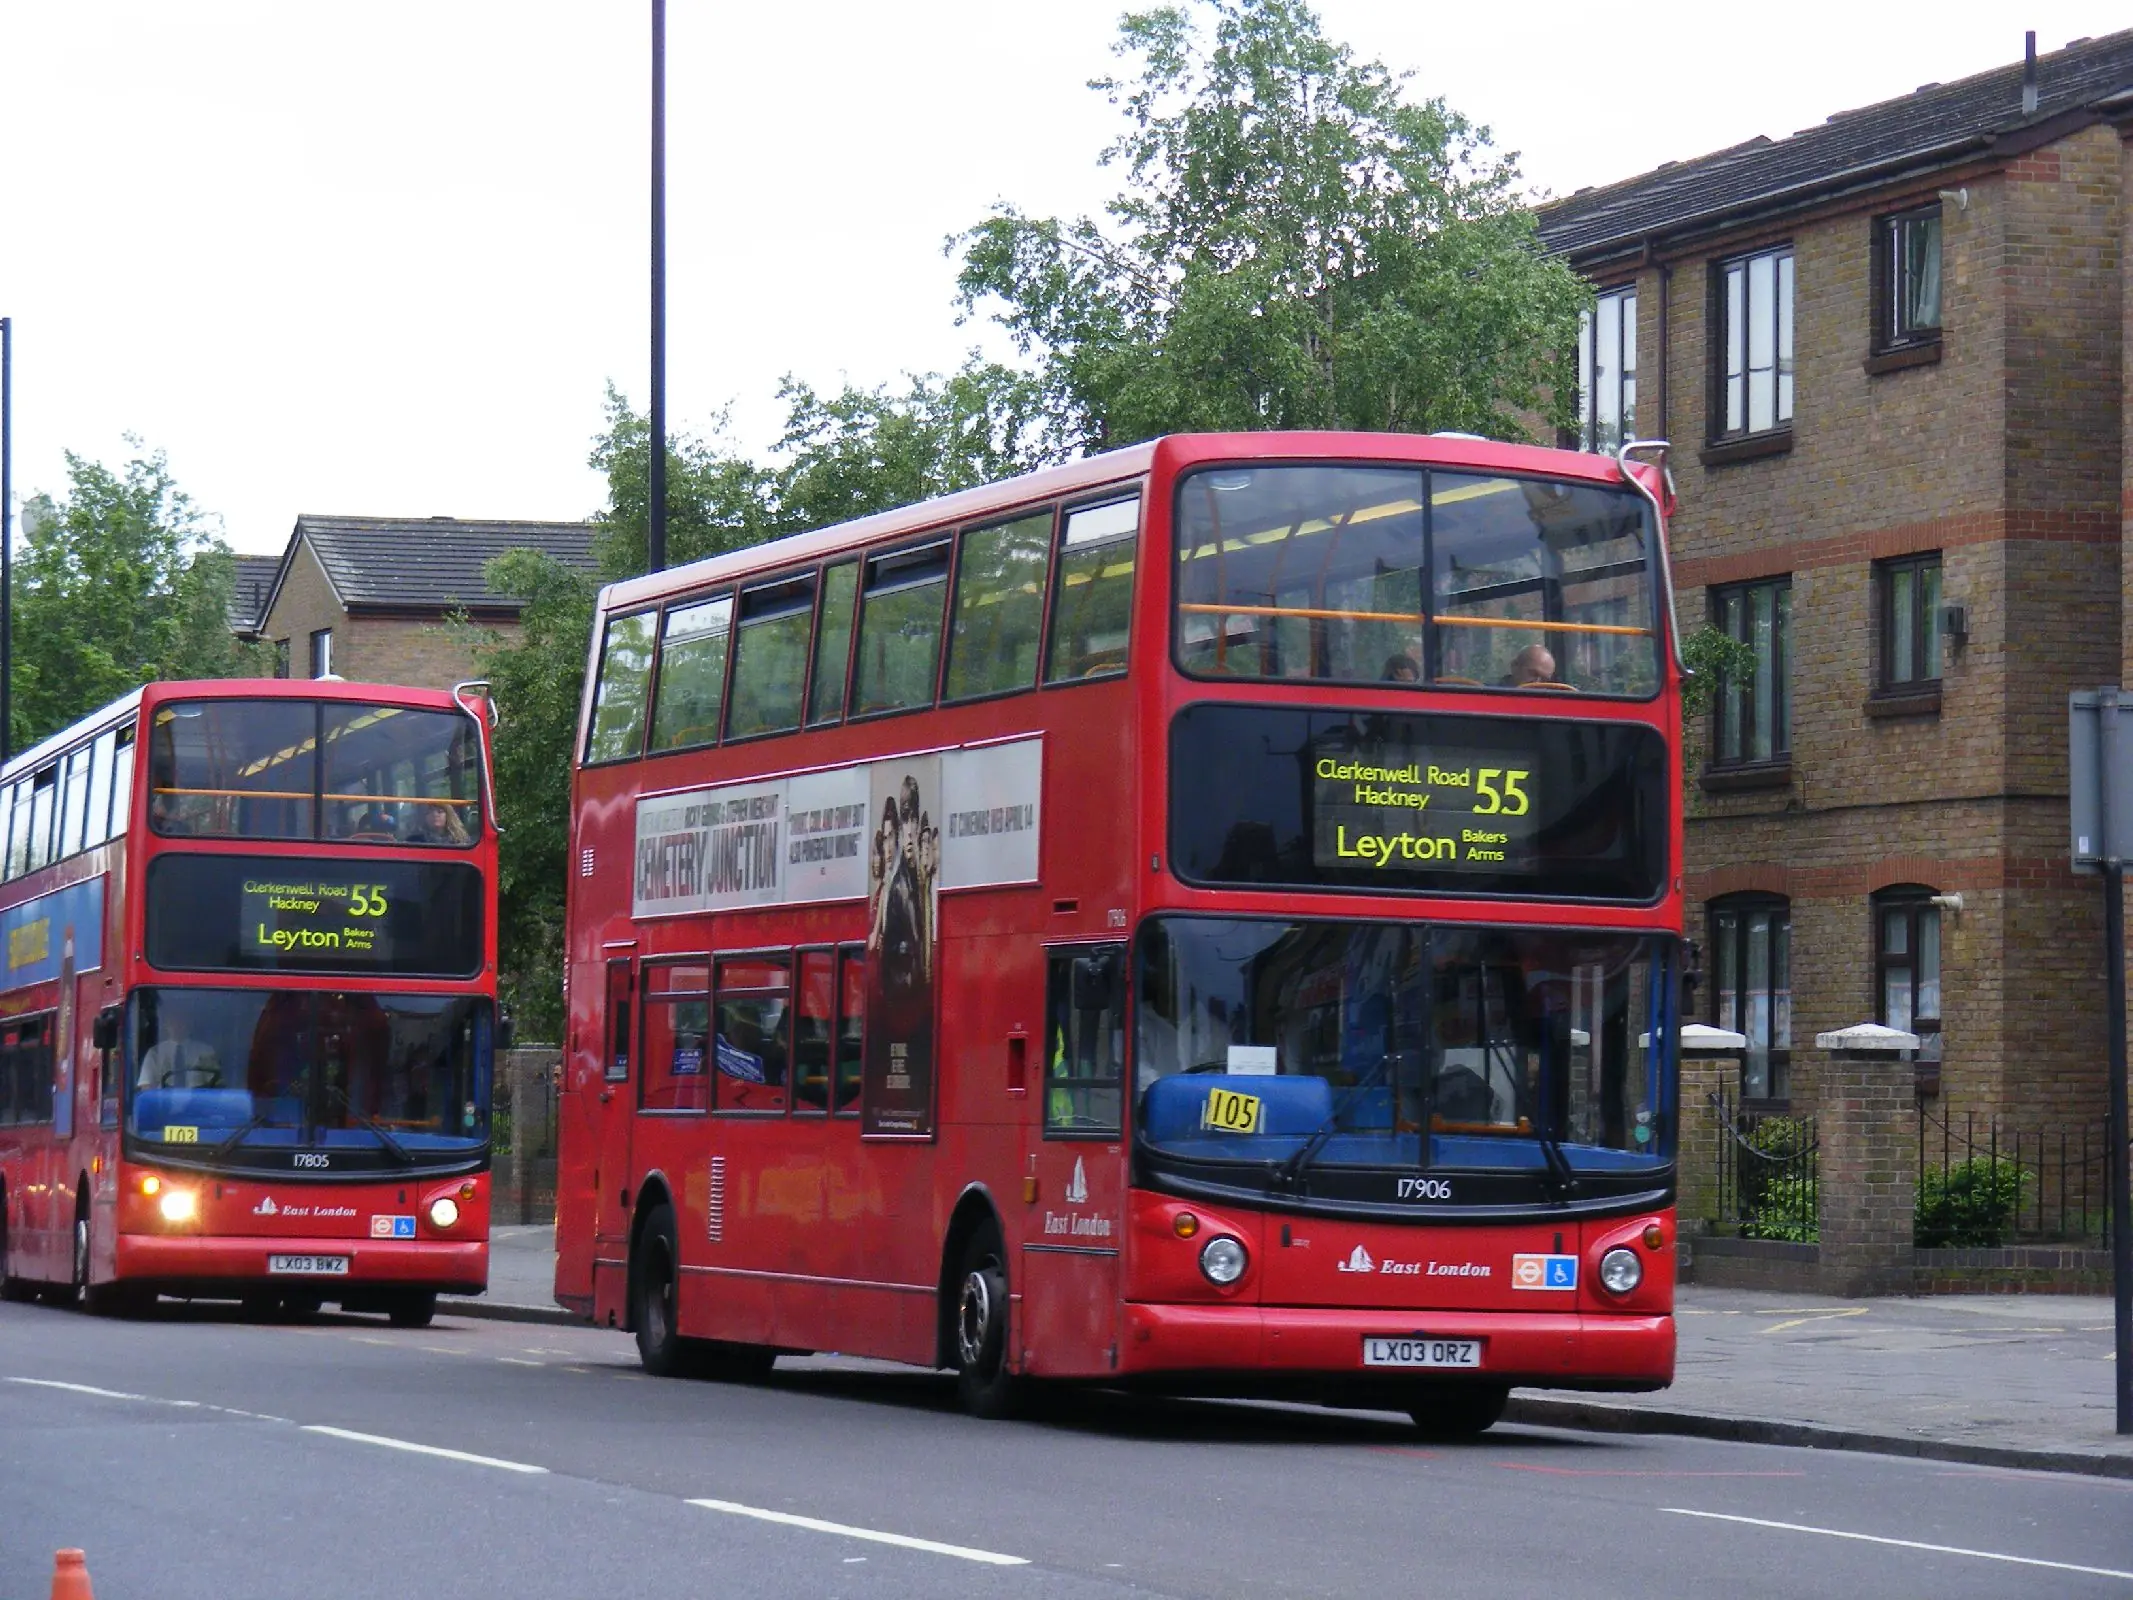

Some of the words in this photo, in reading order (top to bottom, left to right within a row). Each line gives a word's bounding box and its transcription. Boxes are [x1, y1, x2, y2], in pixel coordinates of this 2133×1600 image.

[1315, 758, 1421, 784] Clerkenwell
[1427, 765, 1470, 787] Road
[1354, 783, 1430, 810] Hackney
[1471, 768, 1530, 816] 55
[1461, 828, 1509, 844] Bakers
[1336, 825, 1457, 867] Leyton
[1465, 847, 1505, 861] Arms
[637, 831, 708, 901] CEMETERY
[708, 821, 778, 895] JUNCTION
[243, 880, 315, 895] Clerkenwell
[318, 883, 349, 897] Road
[269, 896, 320, 914] Hackney
[348, 884, 388, 917] 55
[257, 923, 340, 951] Leyton
[343, 927, 375, 938] Bakers
[345, 939, 373, 949] Arms
[1212, 1091, 1256, 1129] 105
[293, 1153, 330, 1168] 17805
[1397, 1178, 1452, 1199] 17906
[281, 1204, 309, 1216] East
[313, 1206, 357, 1217] London
[275, 1257, 312, 1271] LX03
[316, 1257, 343, 1271] BWZ
[1380, 1259, 1421, 1275] East
[1426, 1261, 1492, 1277] London
[1372, 1341, 1426, 1362] LX03
[1432, 1342, 1473, 1363] ORZ
